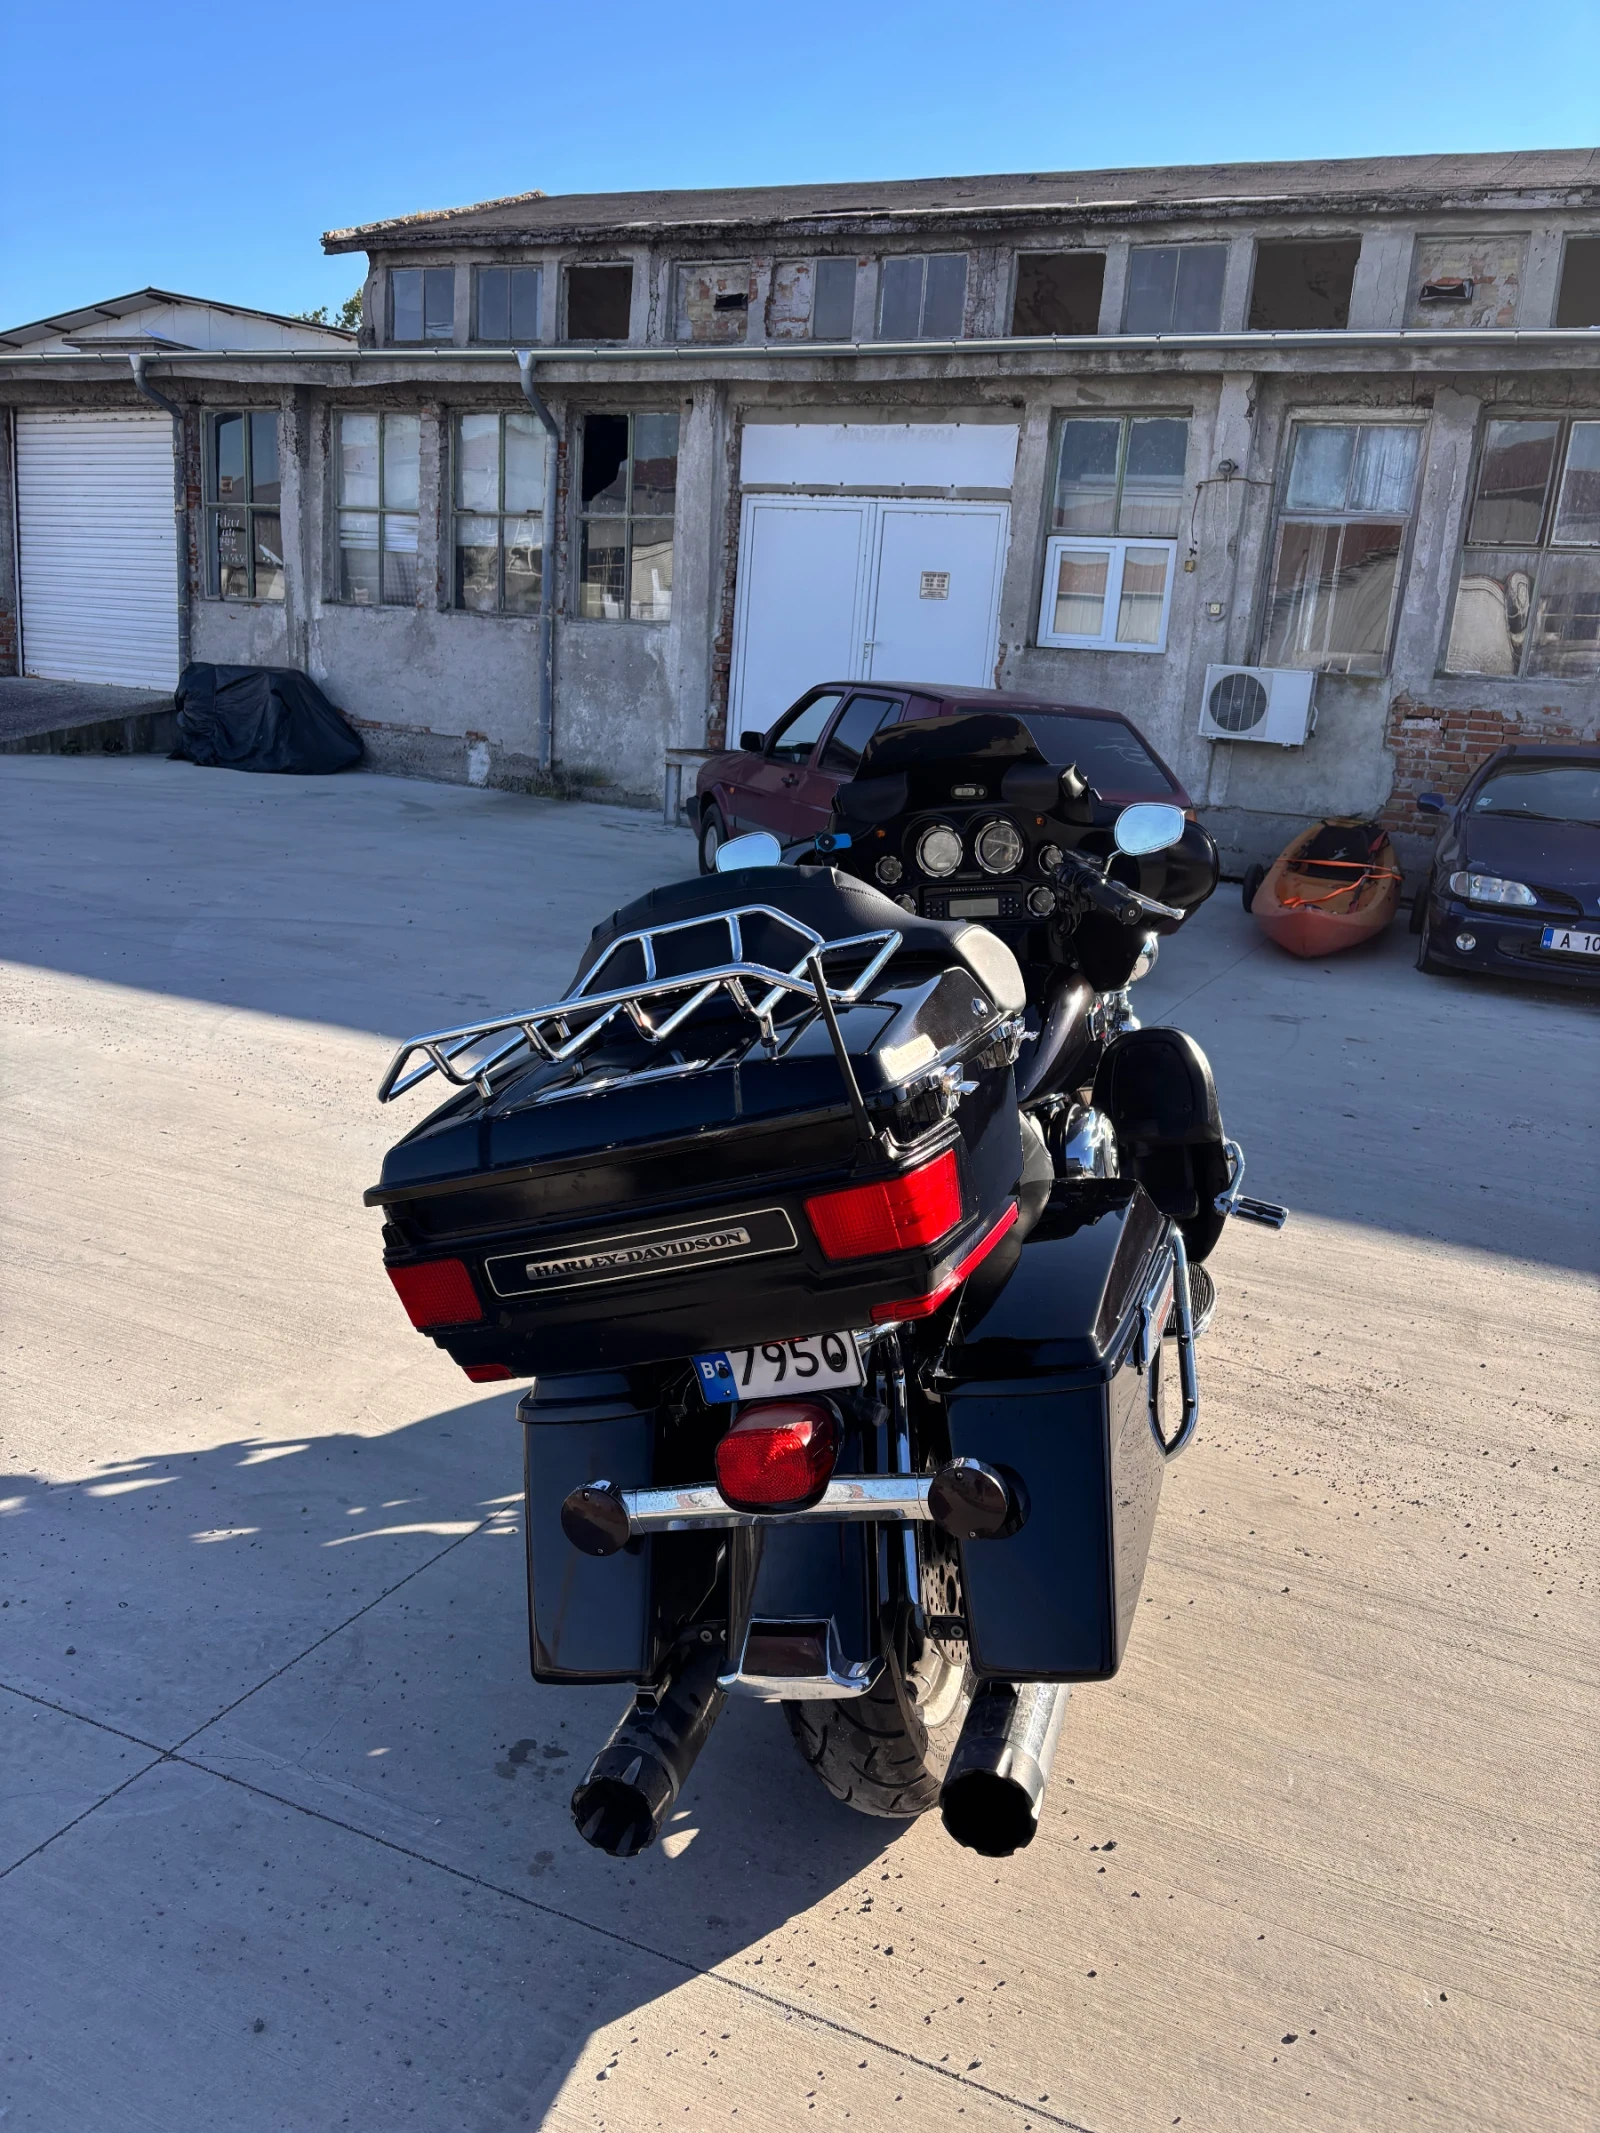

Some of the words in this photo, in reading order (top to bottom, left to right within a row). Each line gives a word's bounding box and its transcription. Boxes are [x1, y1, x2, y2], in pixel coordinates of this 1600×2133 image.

[1560, 933, 1570, 948] A
[1584, 936, 1600, 952] 10
[533, 1232, 743, 1278] HARLEY-DAVIDSON
[731, 1334, 848, 1387] 7950
